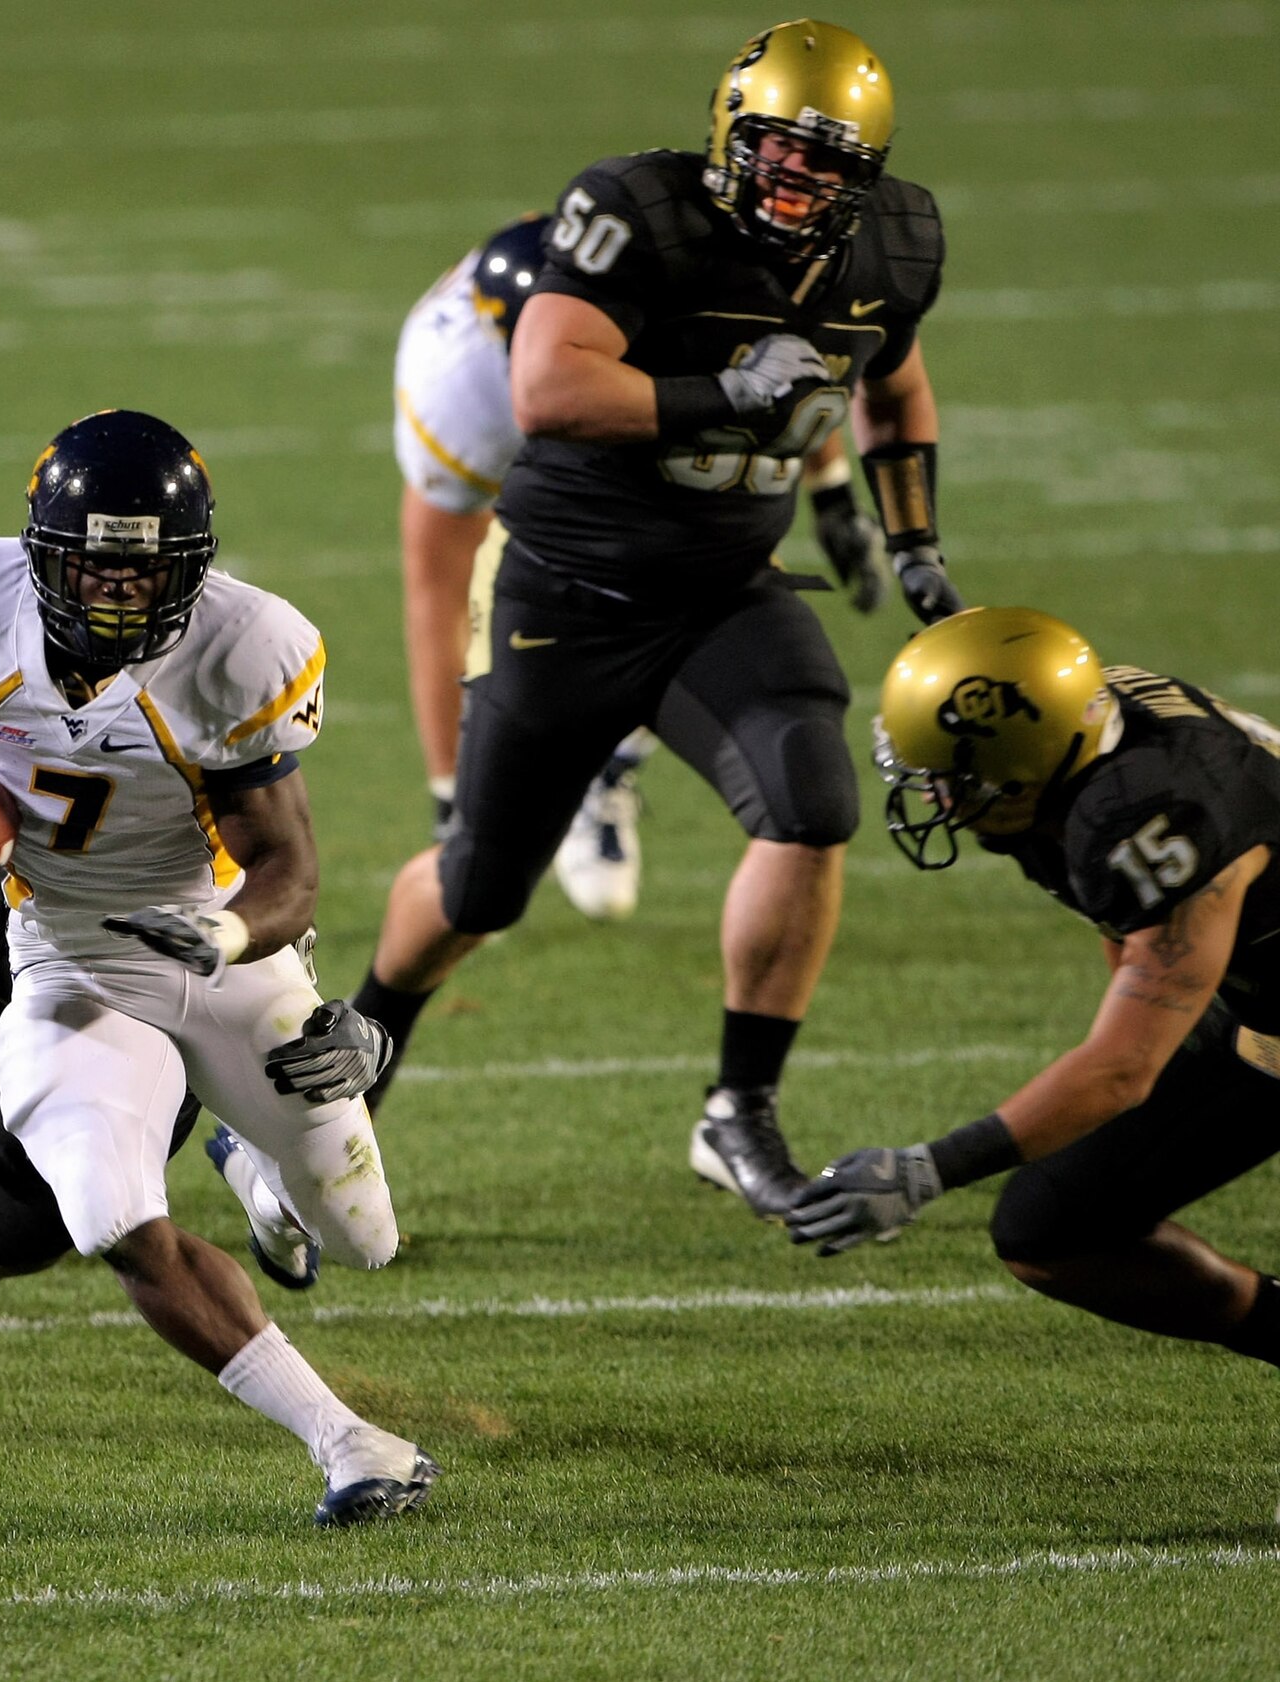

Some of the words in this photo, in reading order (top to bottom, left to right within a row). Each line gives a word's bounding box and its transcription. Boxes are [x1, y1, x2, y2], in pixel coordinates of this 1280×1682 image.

[552, 187, 633, 275] 50
[29, 764, 117, 855] 7
[1106, 813, 1200, 910] 15
